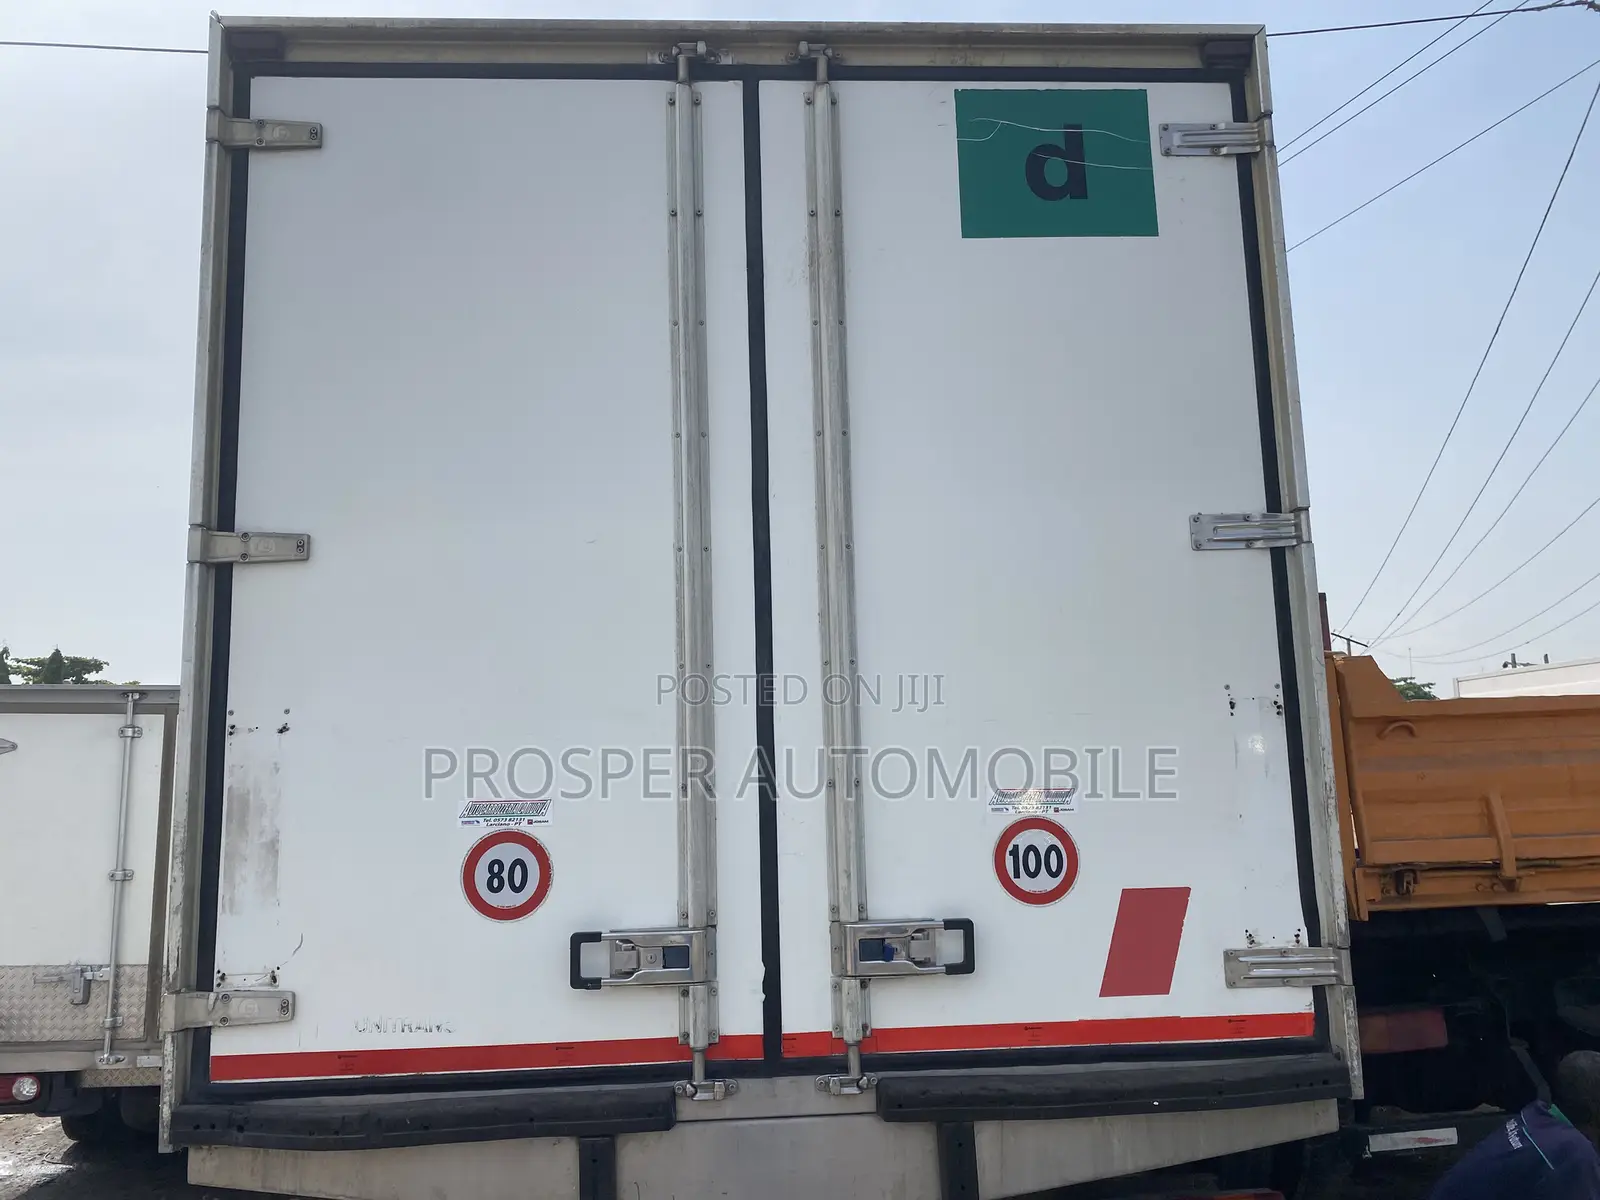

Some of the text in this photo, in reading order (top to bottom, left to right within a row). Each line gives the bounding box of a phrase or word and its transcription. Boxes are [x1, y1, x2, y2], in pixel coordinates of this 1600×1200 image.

[1025, 123, 1088, 201] d
[486, 858, 529, 894] 80
[1009, 844, 1064, 879] 100
